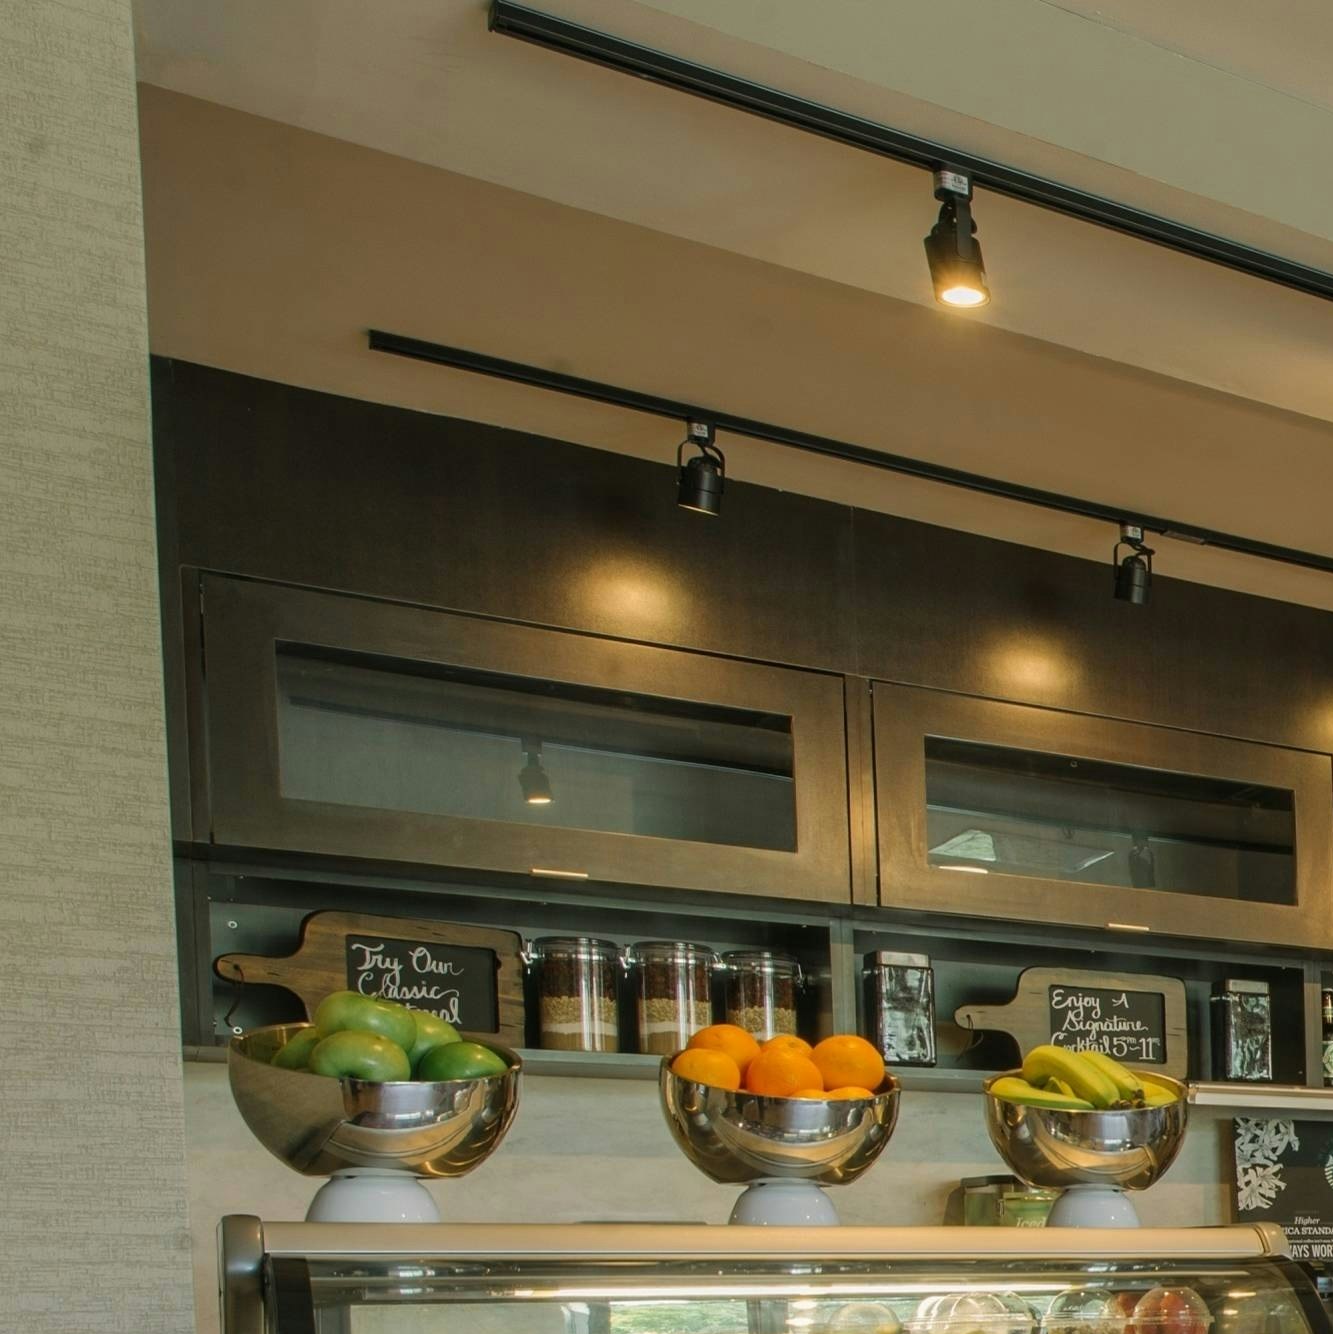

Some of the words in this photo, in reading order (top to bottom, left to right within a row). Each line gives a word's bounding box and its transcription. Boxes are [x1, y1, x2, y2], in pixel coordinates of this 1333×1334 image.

[352, 943, 403, 986] Try
[408, 947, 464, 976] Our
[358, 971, 460, 999] Classic
[1051, 989, 1101, 1021] Enjoy
[1112, 992, 1129, 1009] A
[1062, 1010, 1149, 1041] Signature
[1294, 1216, 1321, 1226] Higher
